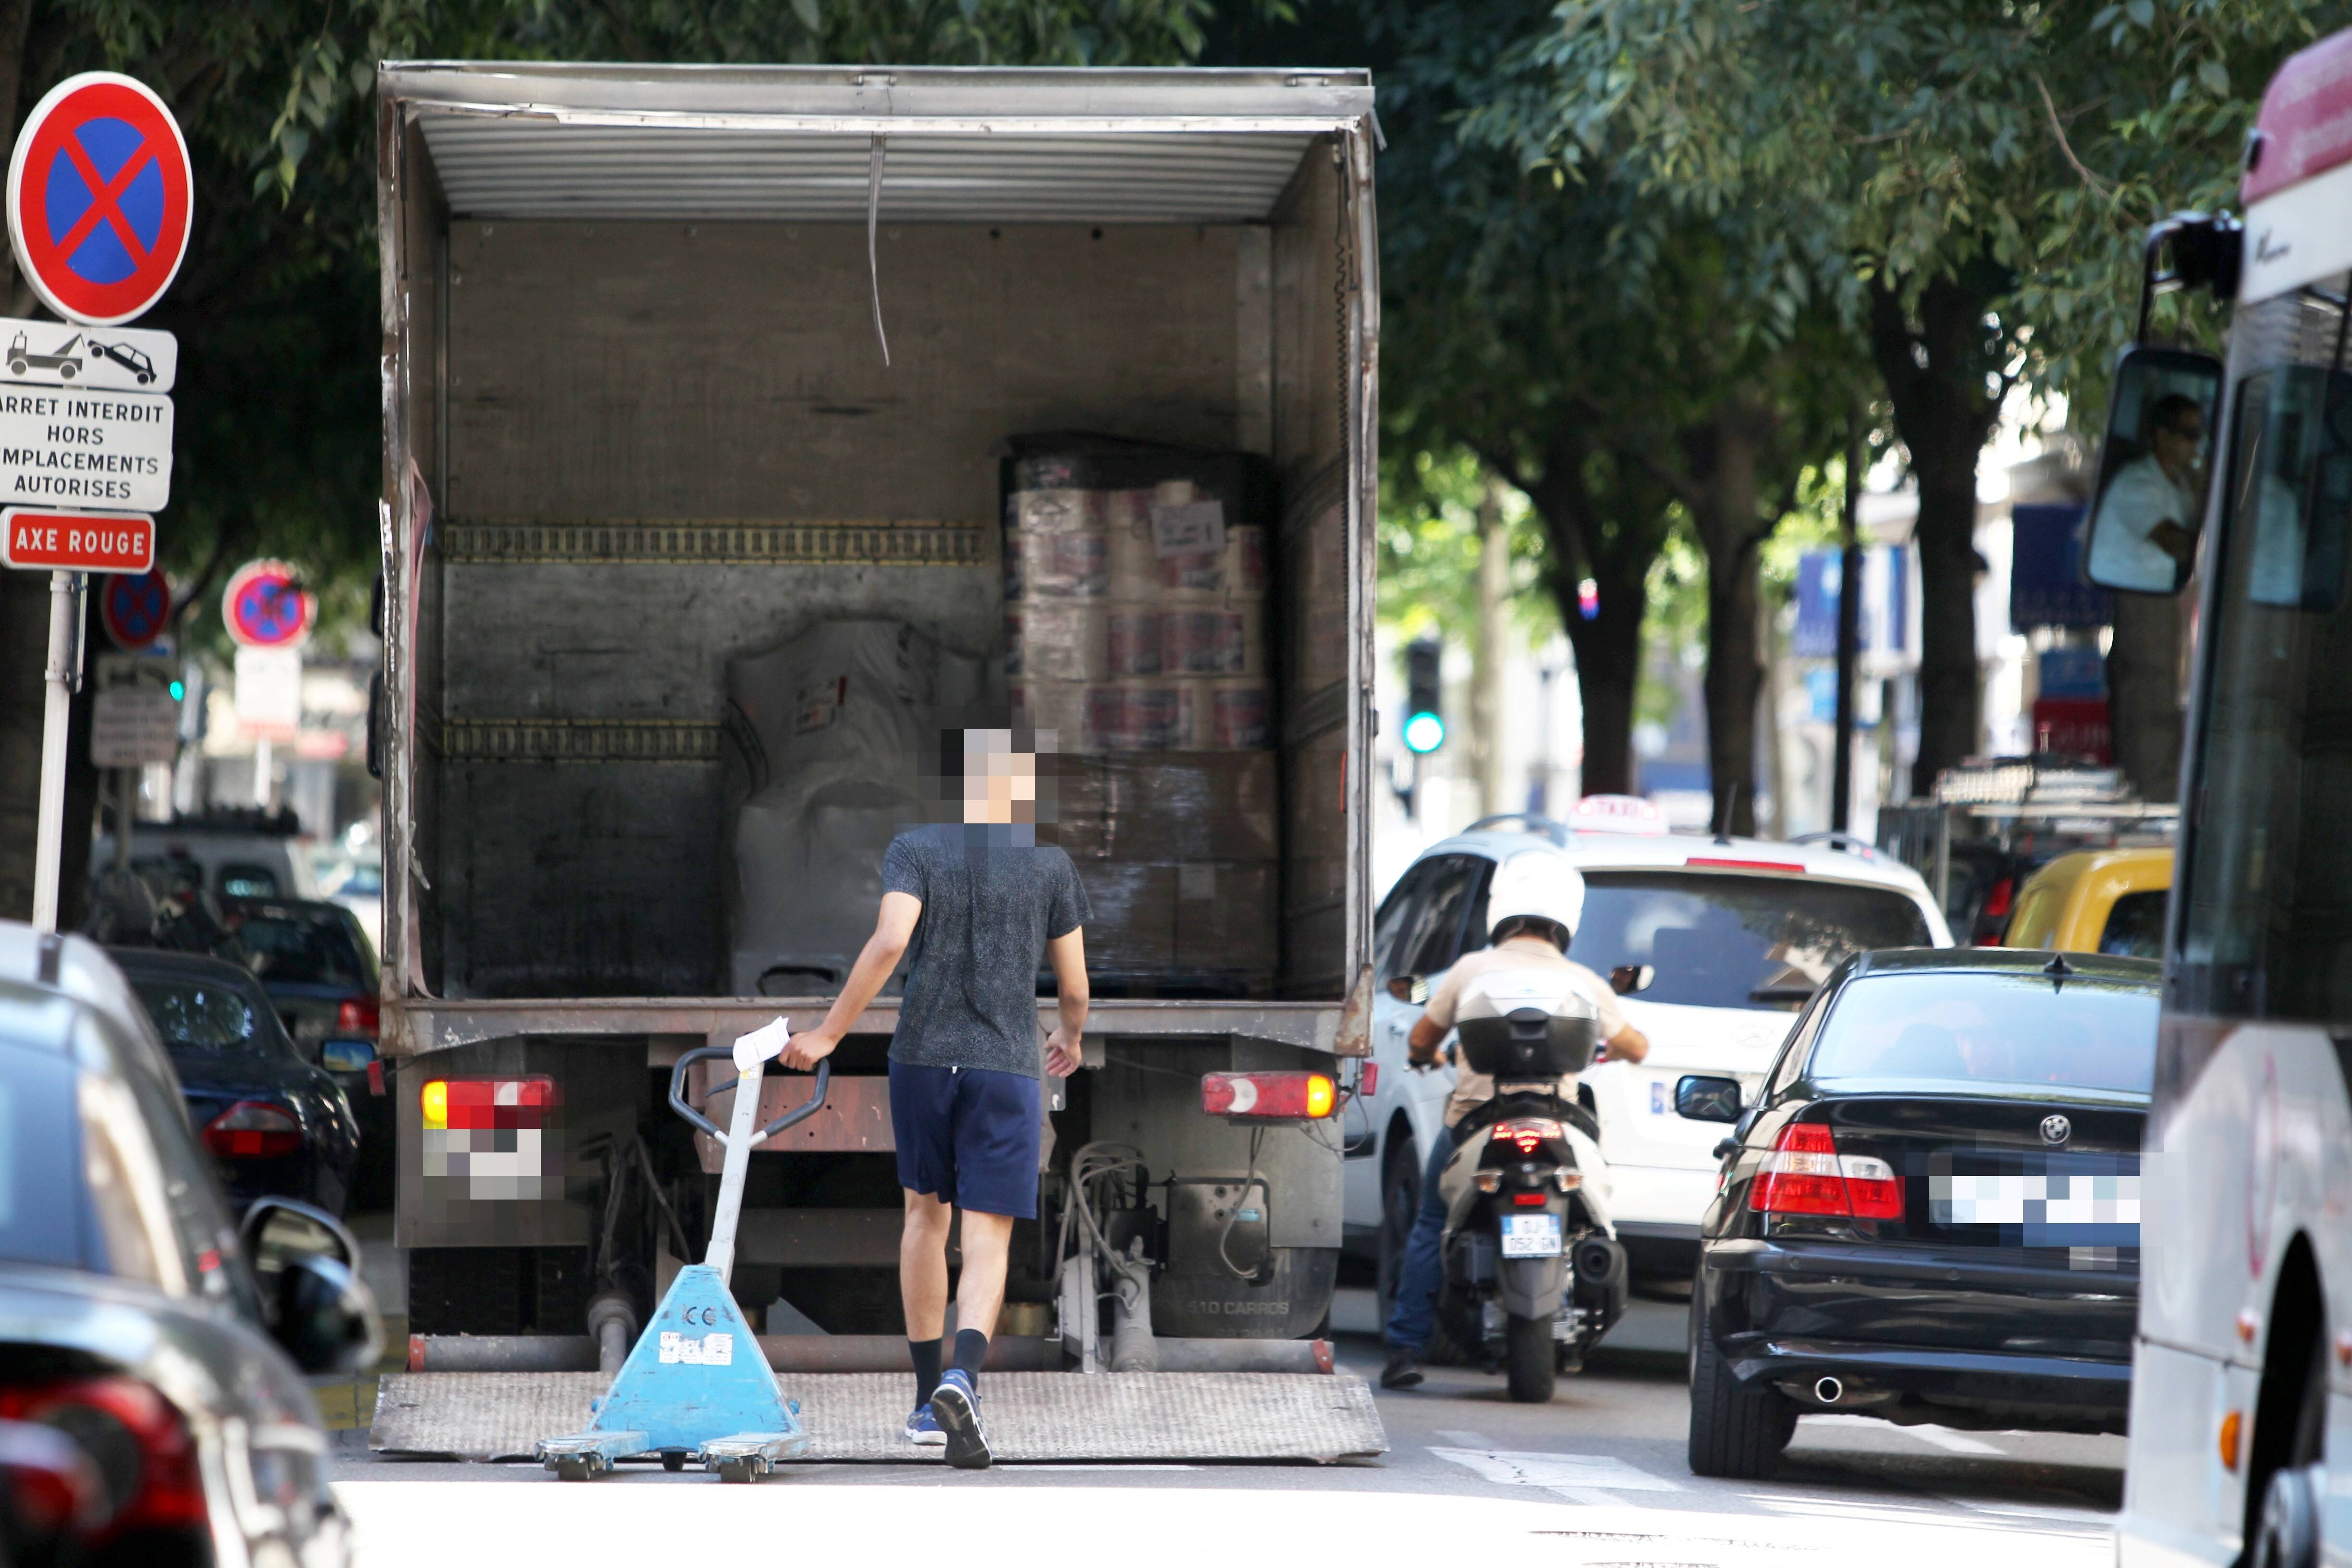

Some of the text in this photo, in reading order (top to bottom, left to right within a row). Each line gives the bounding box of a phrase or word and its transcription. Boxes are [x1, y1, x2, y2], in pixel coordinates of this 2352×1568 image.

[0, 395, 163, 423] RRET INTERDIT
[47, 425, 104, 445] HORS
[0, 448, 158, 474] MPLACEMENTS
[14, 475, 131, 499] AUTORISES
[15, 527, 145, 555] AXE ROUGE
[1596, 800, 1638, 816] TAXI
[1224, 1301, 1290, 1315] CARROS
